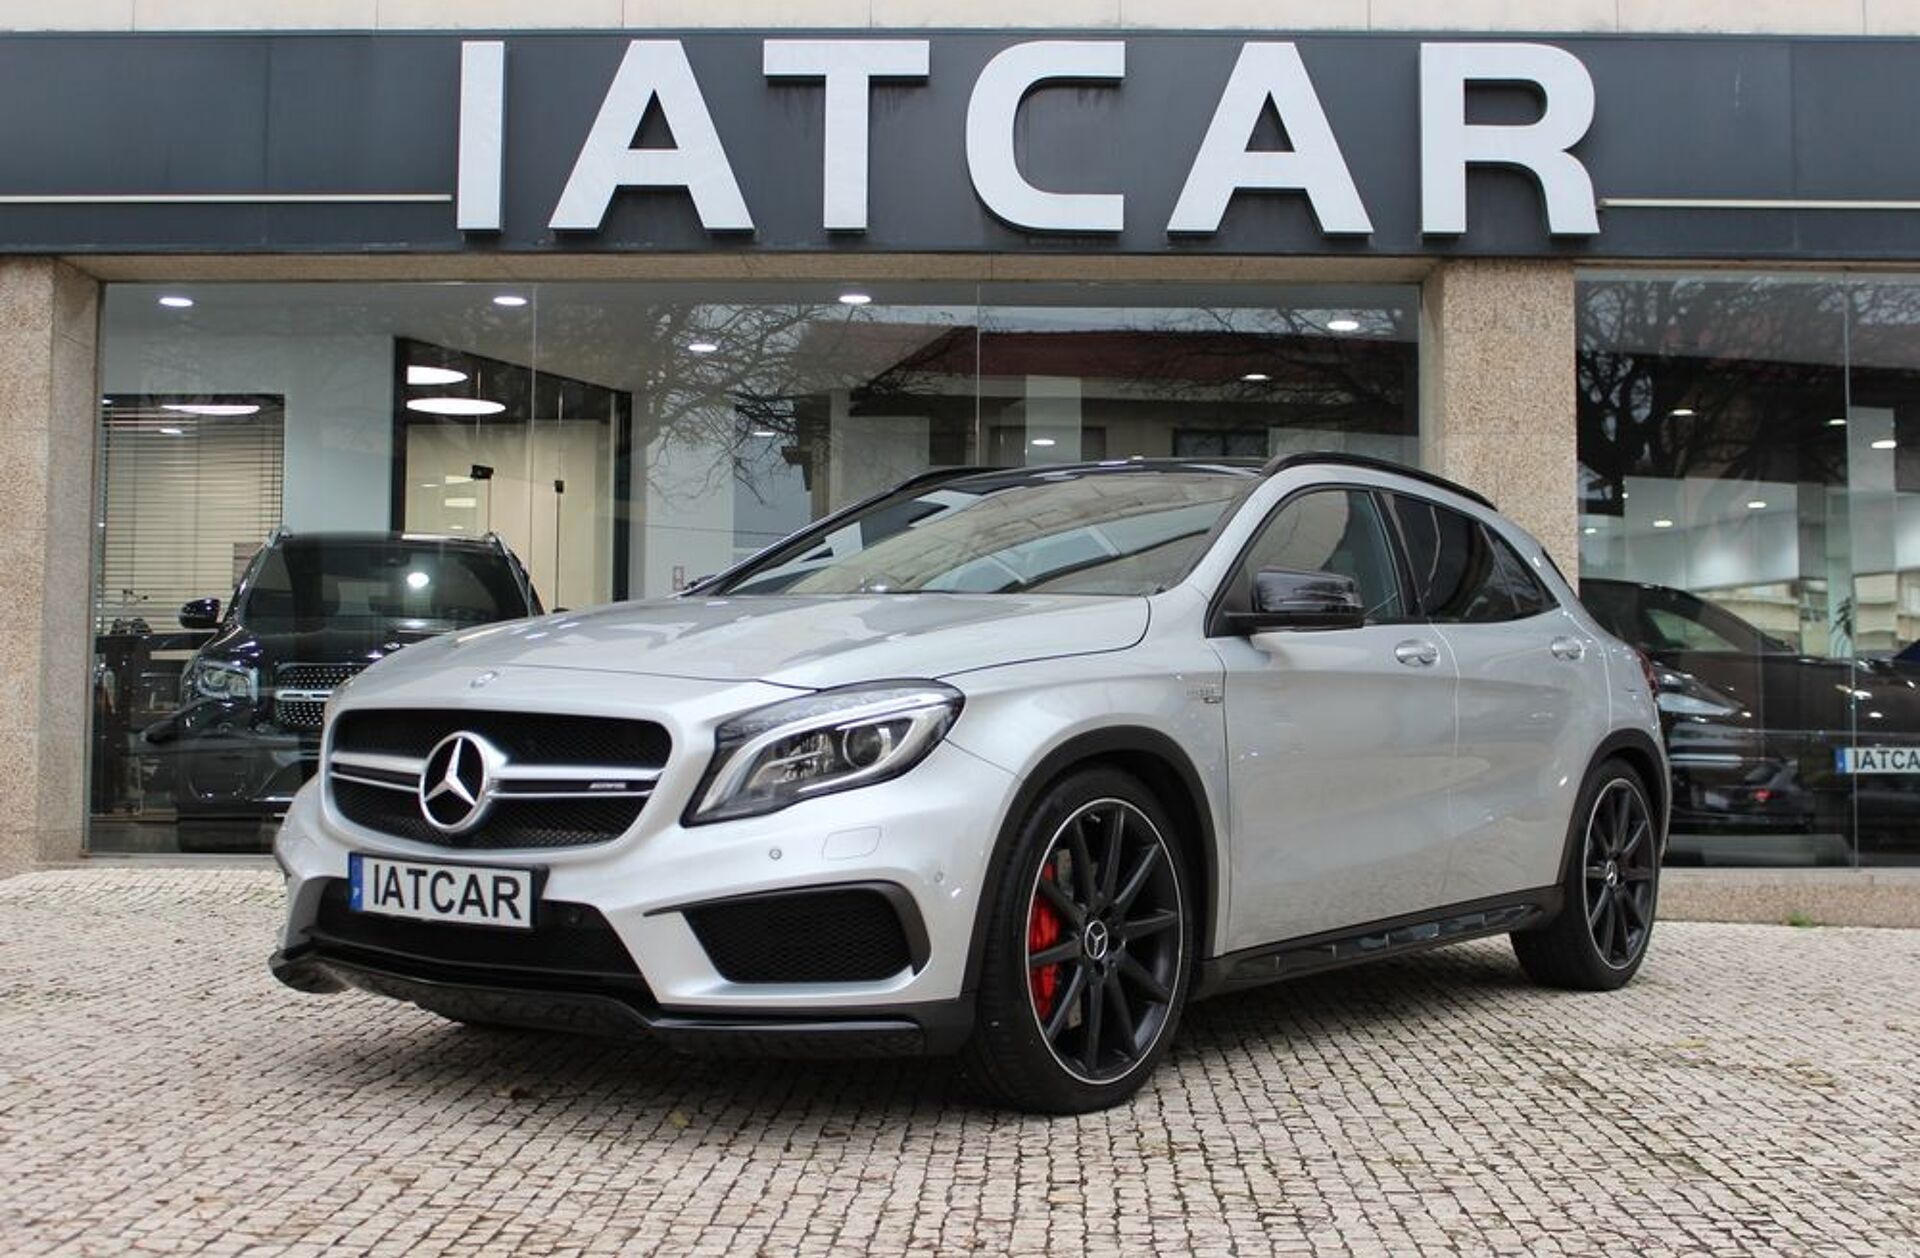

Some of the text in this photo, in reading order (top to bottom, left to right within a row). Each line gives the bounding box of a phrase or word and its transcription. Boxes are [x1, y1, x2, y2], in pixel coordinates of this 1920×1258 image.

[457, 39, 1601, 236] IATCAR
[1854, 750, 1920, 769] IATCA
[373, 864, 521, 920] IATCAR
